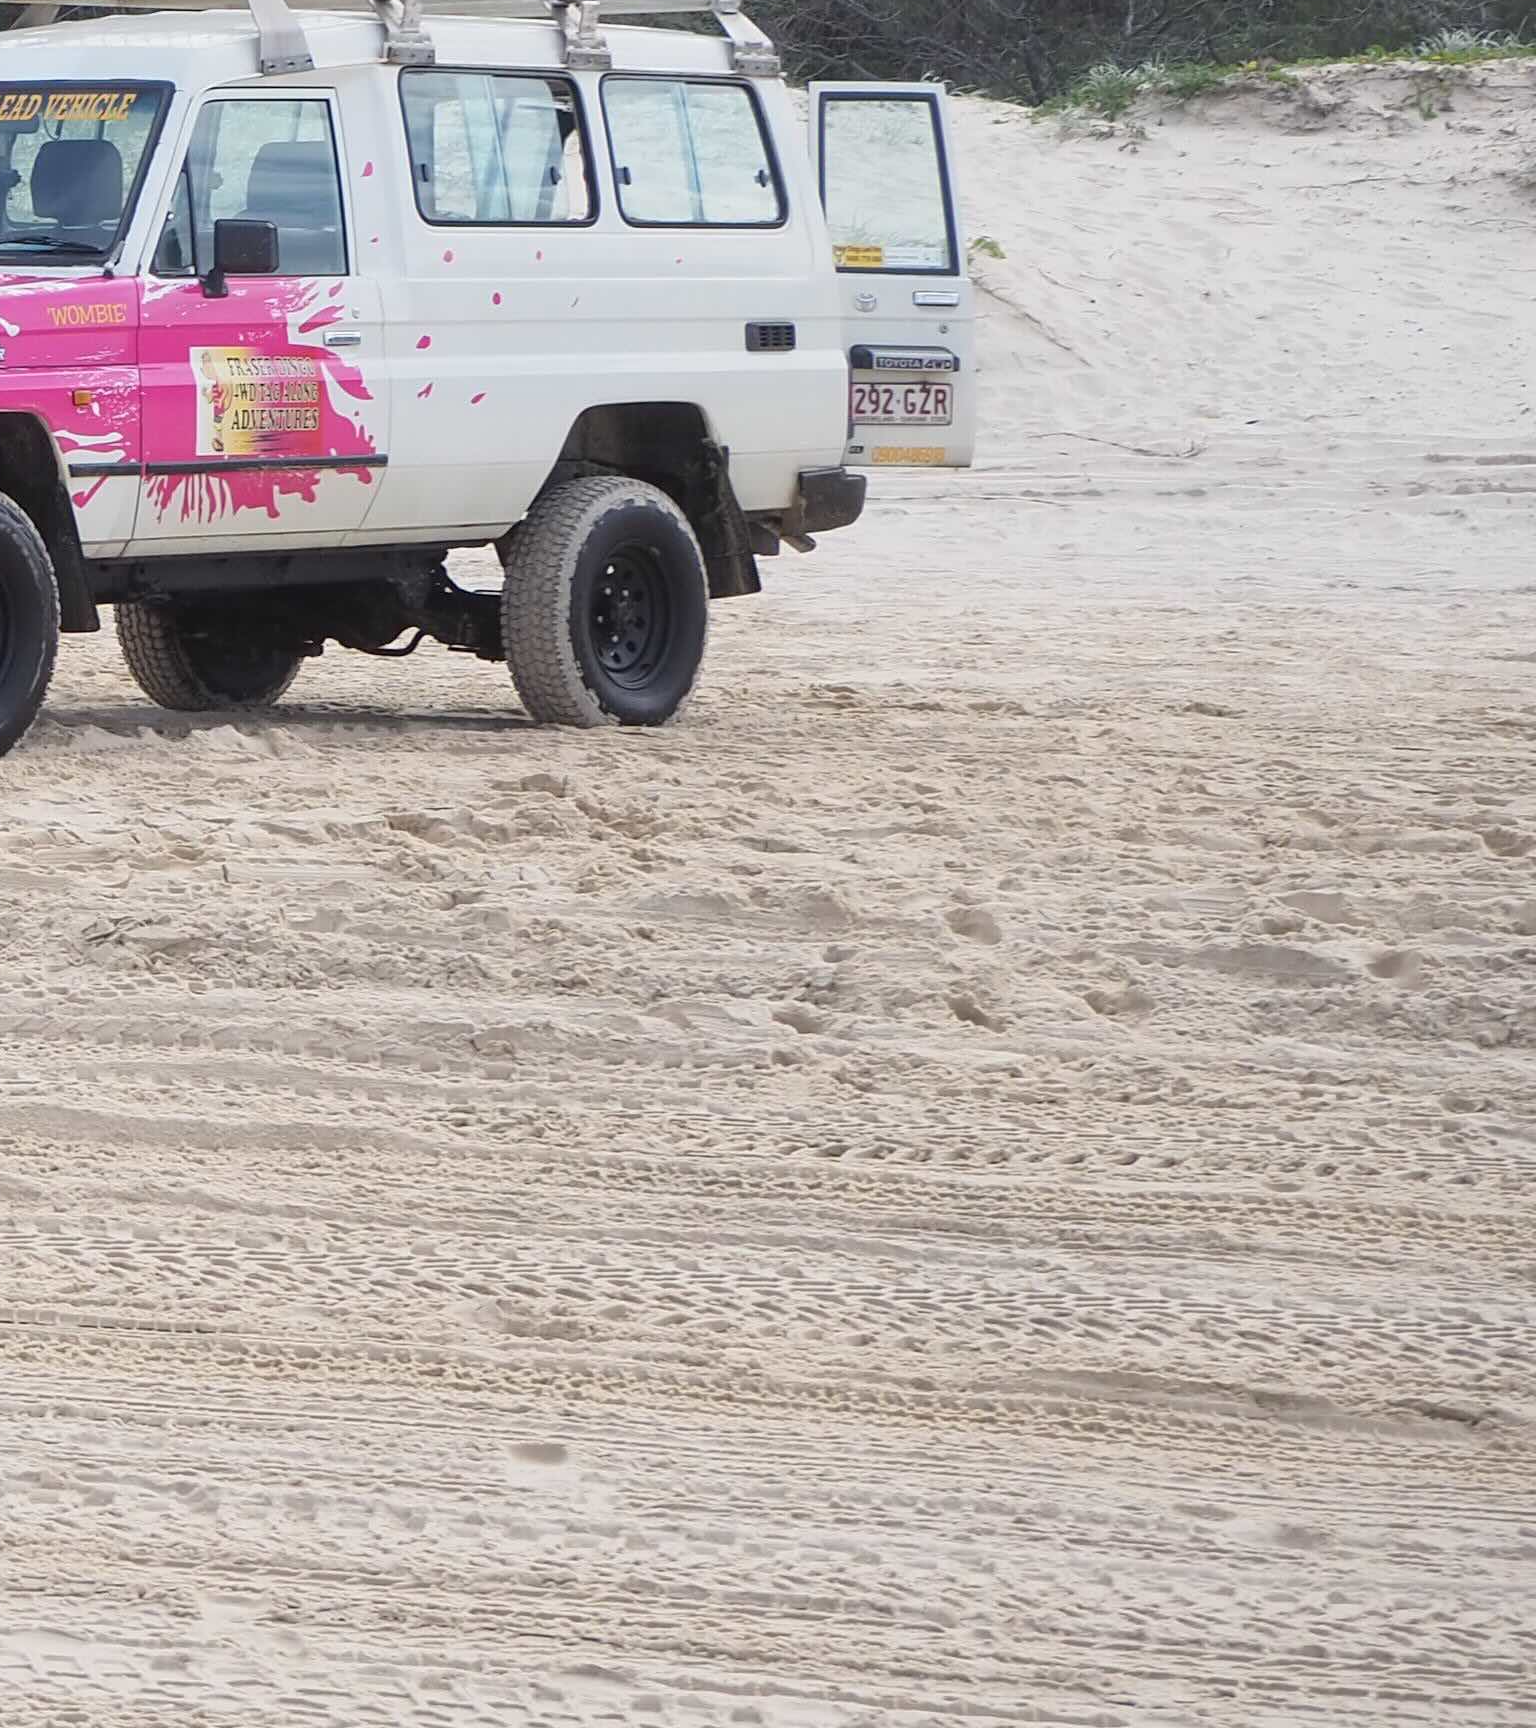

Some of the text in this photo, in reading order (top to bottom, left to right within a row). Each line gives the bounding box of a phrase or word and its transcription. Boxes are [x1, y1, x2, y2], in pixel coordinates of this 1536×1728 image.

[43, 93, 137, 121] VEHICLE
[48, 304, 127, 326] 'WOMBIE'
[227, 357, 315, 376] FRASER DINGO
[878, 358, 952, 369] TOYOTA 4WD
[258, 383, 281, 401] TAG
[284, 383, 319, 401] ALONG
[231, 409, 320, 430] ADVENTURES
